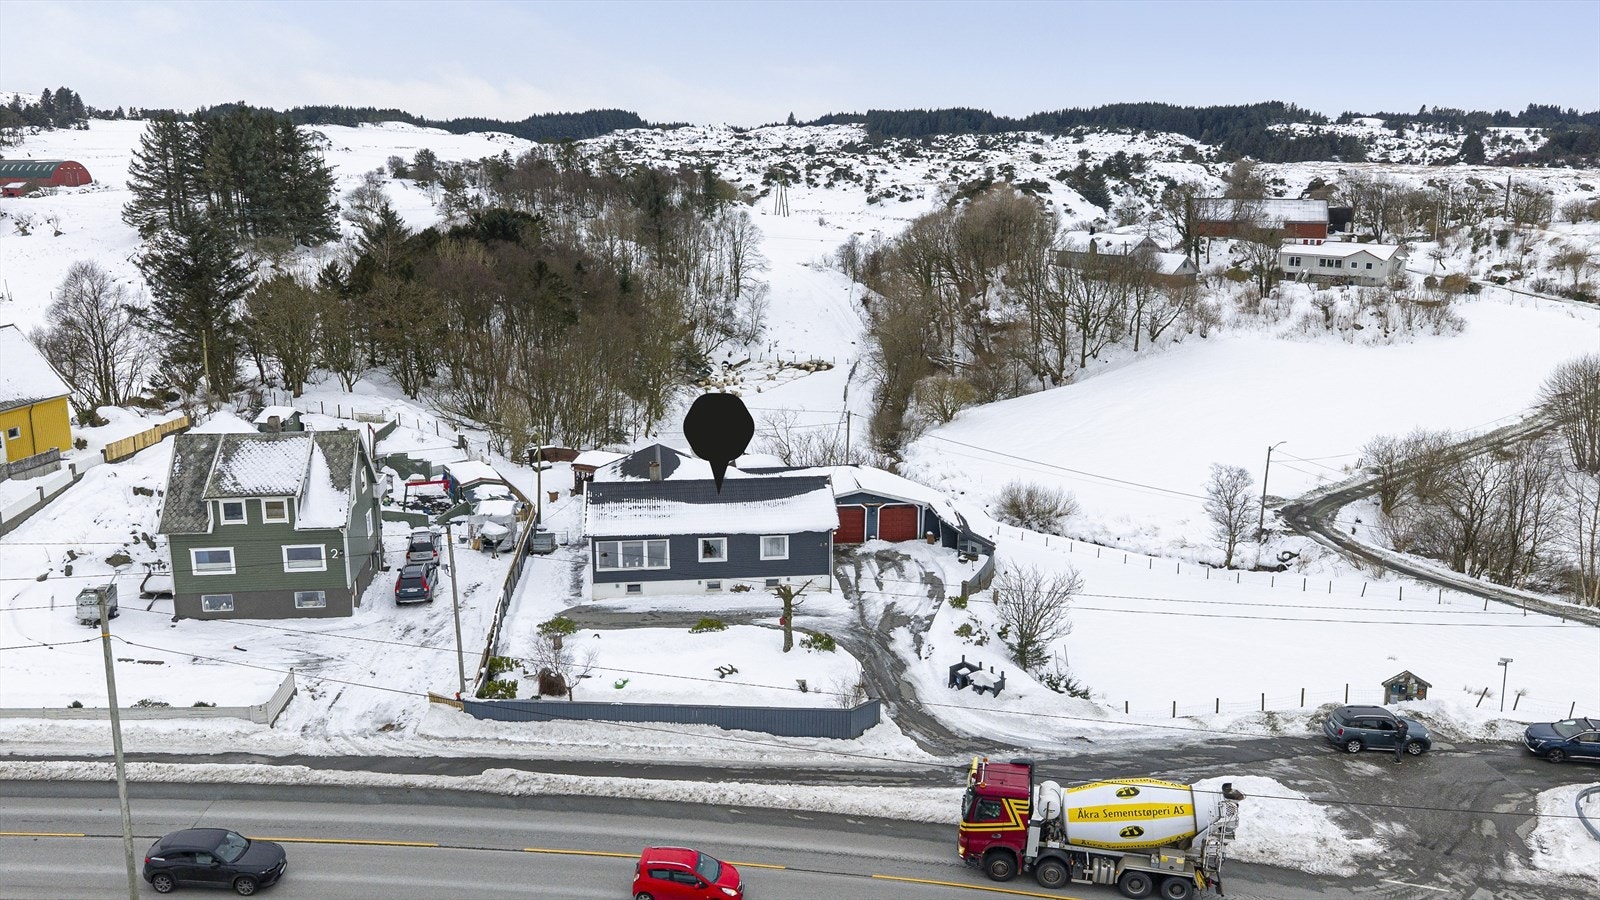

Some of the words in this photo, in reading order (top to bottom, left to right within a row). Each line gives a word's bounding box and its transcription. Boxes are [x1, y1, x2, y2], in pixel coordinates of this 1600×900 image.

[330, 548, 339, 559] 2
[1077, 807, 1100, 819] Åkra
[1102, 806, 1170, 819] Sementstøperi
[1173, 805, 1185, 815] AS
